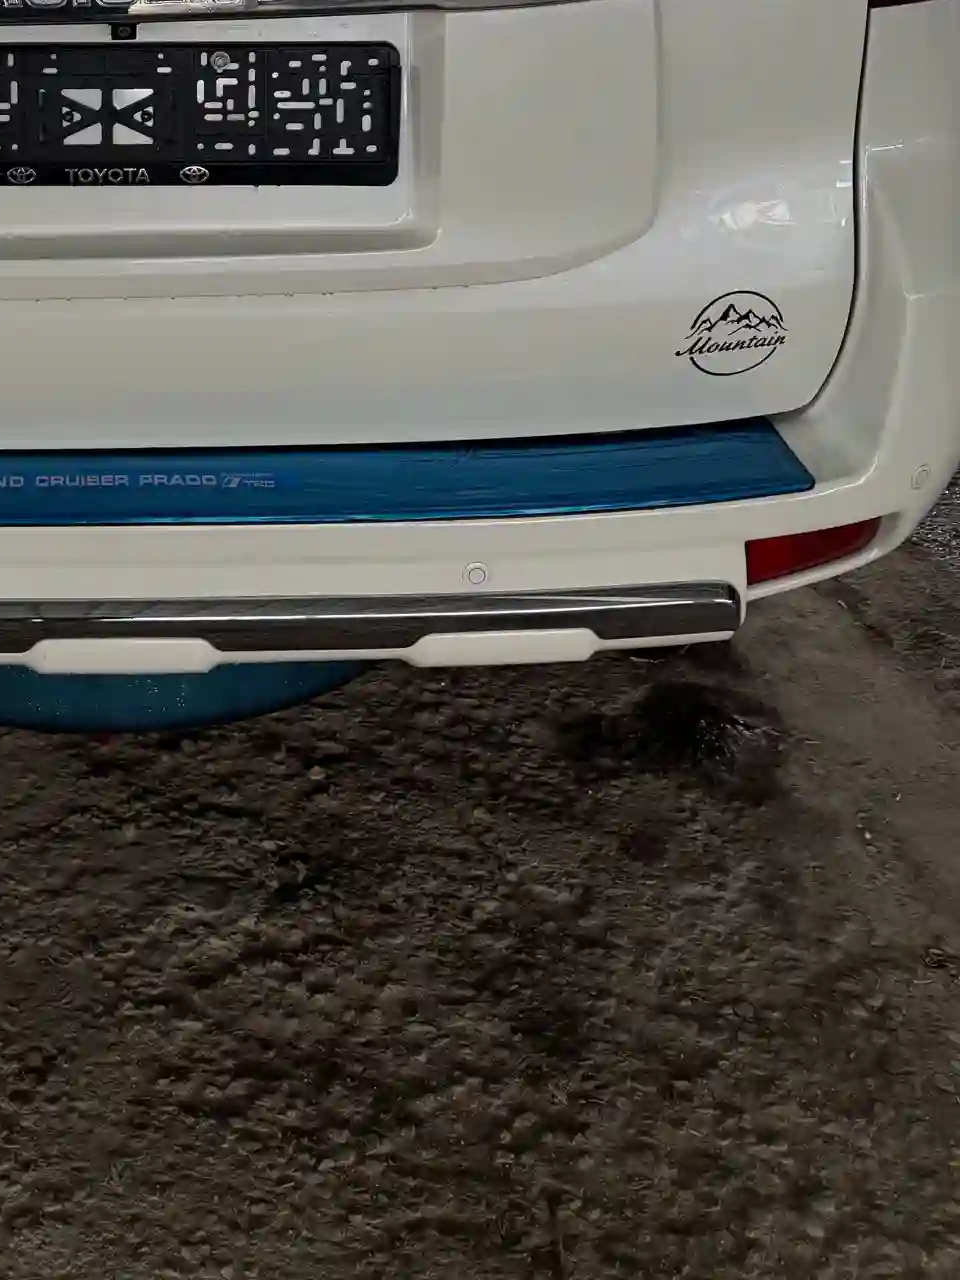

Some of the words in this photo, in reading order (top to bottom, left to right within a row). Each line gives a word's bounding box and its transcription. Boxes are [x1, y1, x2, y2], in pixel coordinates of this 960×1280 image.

[65, 167, 150, 184] TOYOTA
[674, 332, 786, 356] Mountain
[35, 474, 130, 488] CRUISER
[138, 473, 217, 487] PRADO
